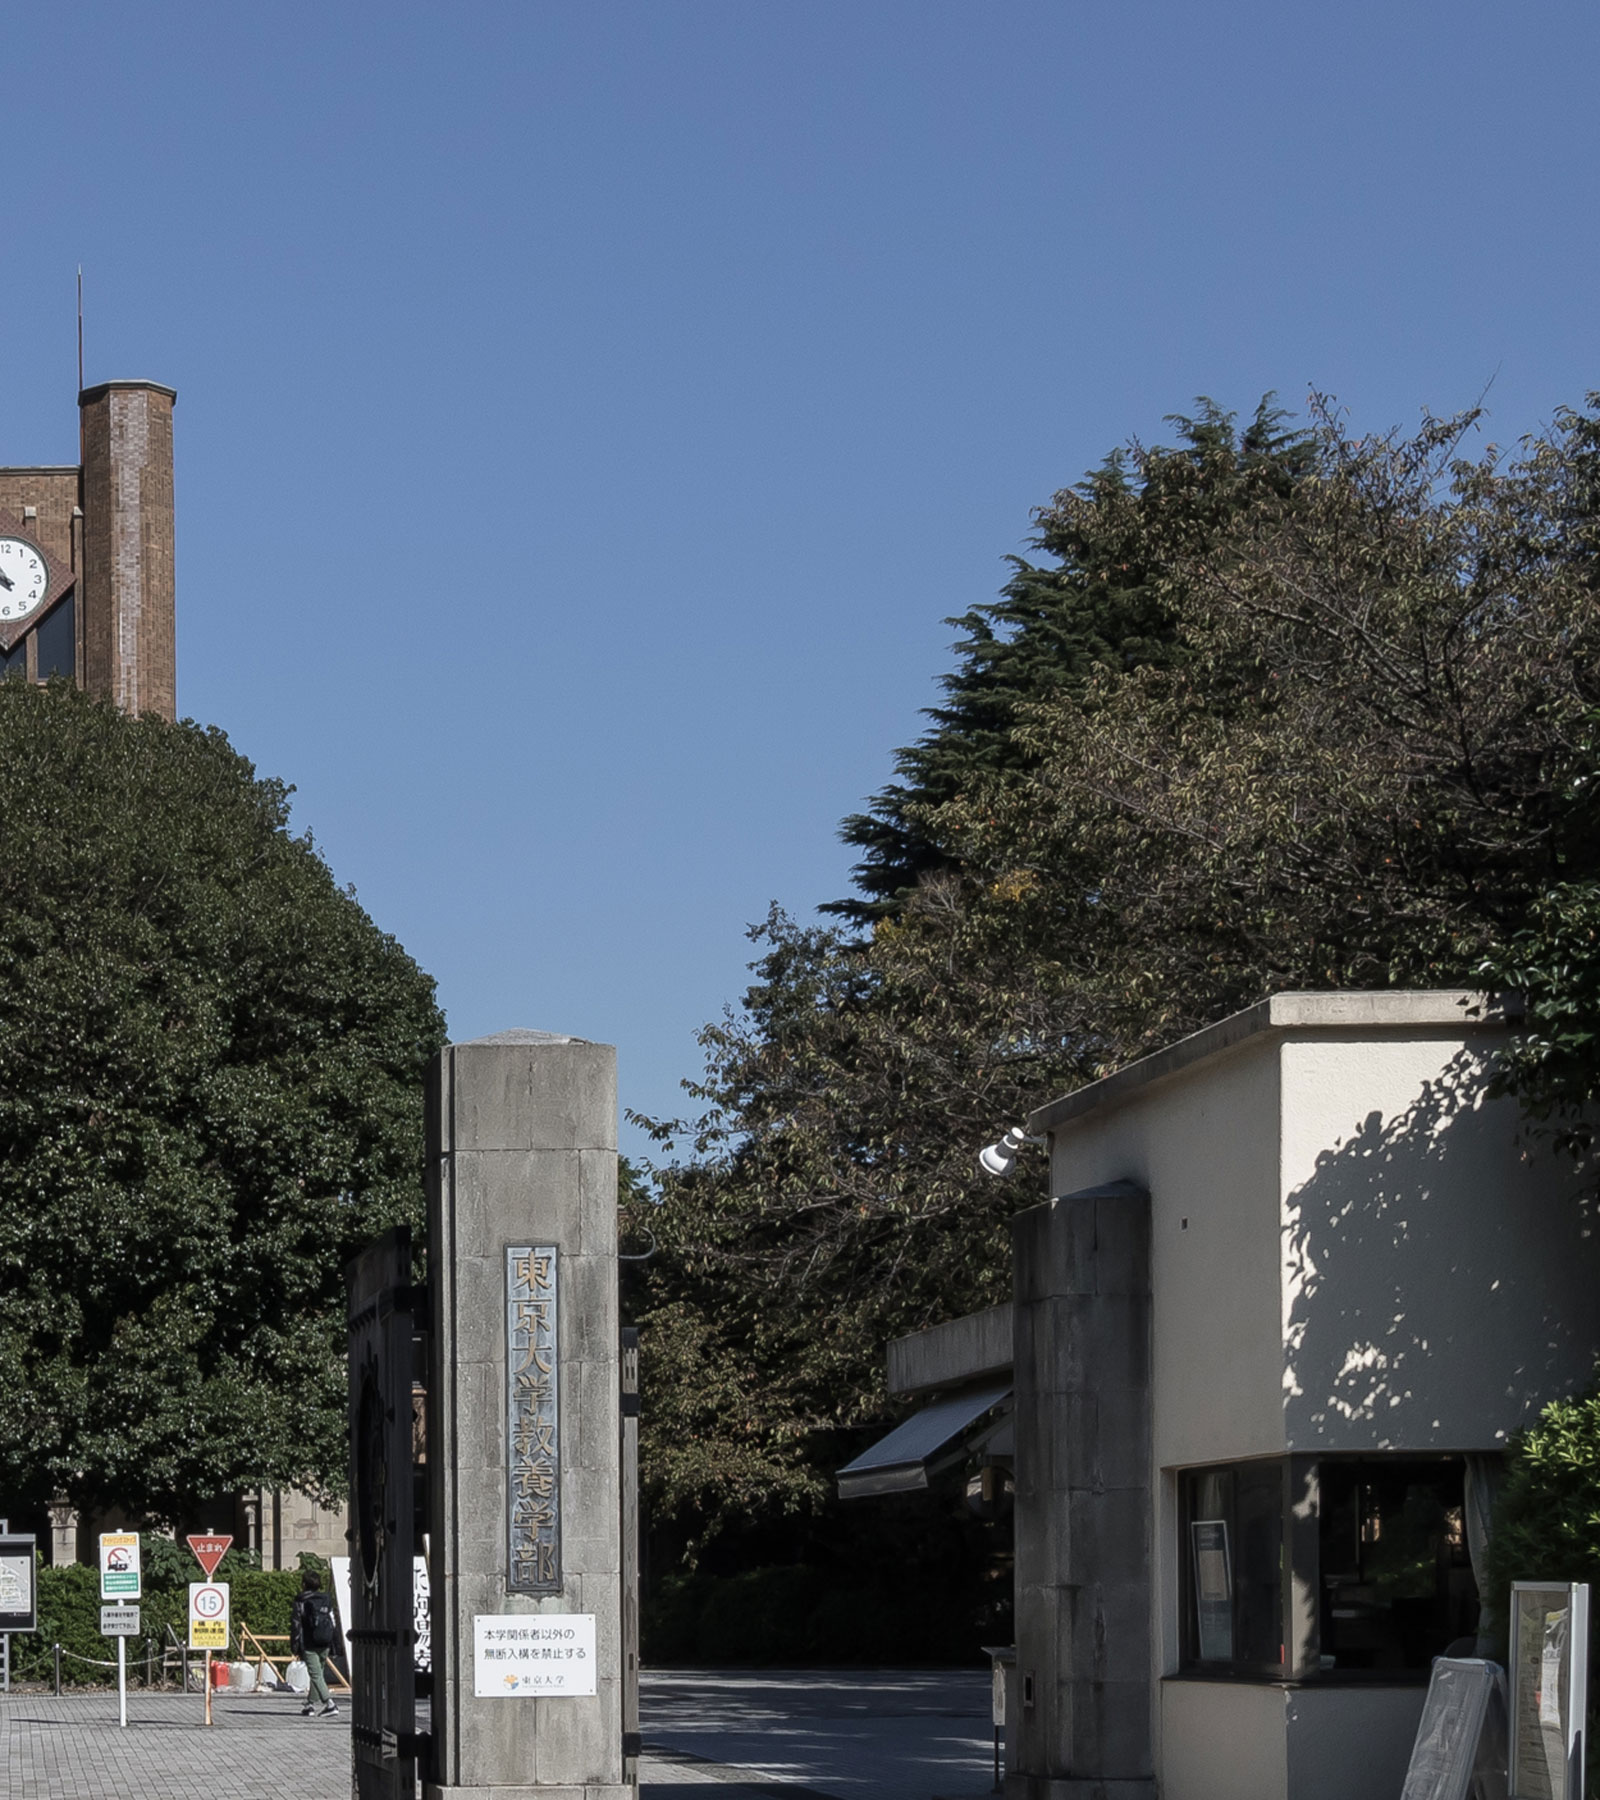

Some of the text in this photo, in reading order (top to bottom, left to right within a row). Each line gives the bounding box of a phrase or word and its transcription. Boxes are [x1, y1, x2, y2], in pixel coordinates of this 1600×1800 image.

[0, 544, 11, 554] 12
[19, 549, 23, 558] 1
[29, 559, 37, 569] 2
[33, 574, 42, 584] 3
[28, 590, 37, 599] 4
[2, 606, 11, 616] 6
[18, 601, 27, 611] 5
[512, 1250, 555, 1584] 東京大学教養学部
[197, 1543, 223, 1553] 止まれ
[201, 1596, 217, 1611] 15
[483, 1629, 575, 1640] 本学関係者以外の
[483, 1648, 586, 1660] 無断入構を禁止する
[522, 1675, 564, 1684] 東京大学
